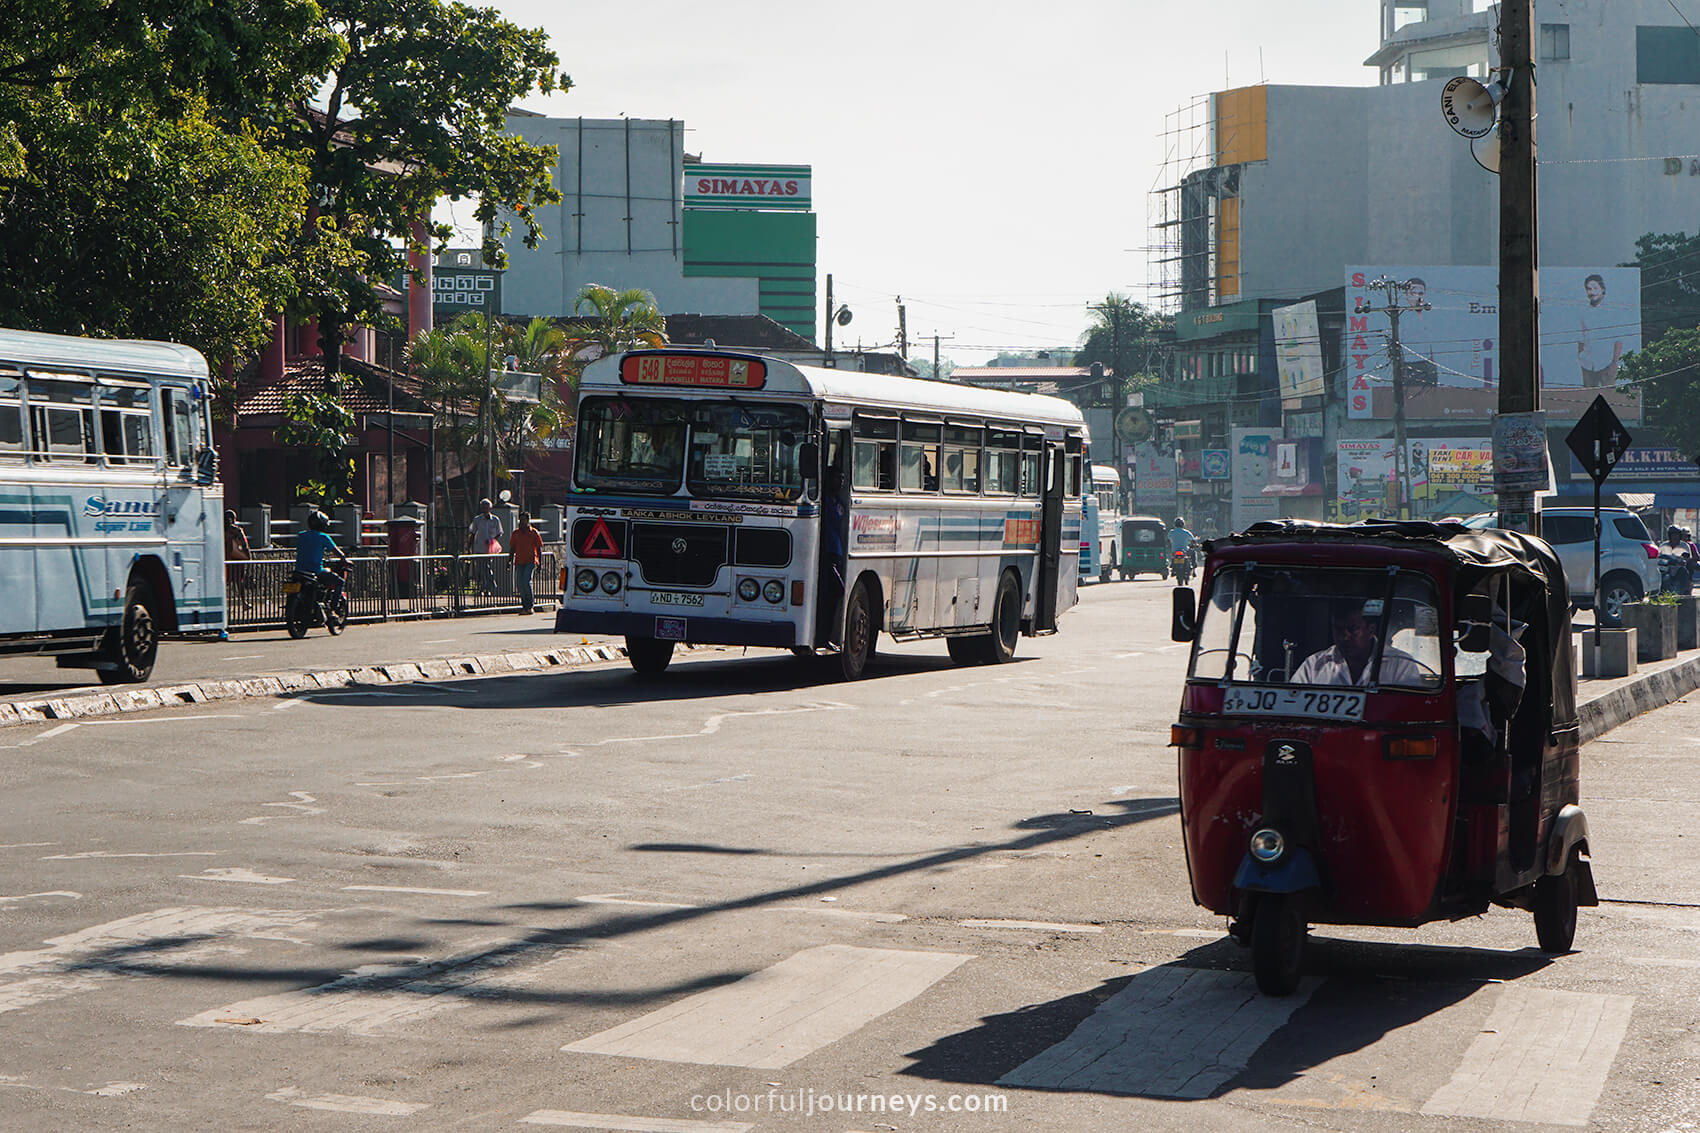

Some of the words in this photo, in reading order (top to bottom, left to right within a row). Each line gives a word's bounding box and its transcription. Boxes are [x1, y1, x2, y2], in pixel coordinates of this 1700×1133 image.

[1444, 96, 1459, 125] GANI
[697, 179, 798, 196] SIMAYAS
[1350, 272, 1369, 411] SIMAYAS
[641, 359, 661, 380] 548
[1455, 451, 1473, 460] CAR
[620, 510, 654, 518] LANKA
[659, 512, 693, 520] ASHOK
[696, 513, 742, 523] LEYLAND
[681, 595, 703, 605] 7562
[1304, 693, 1361, 717] 7872
